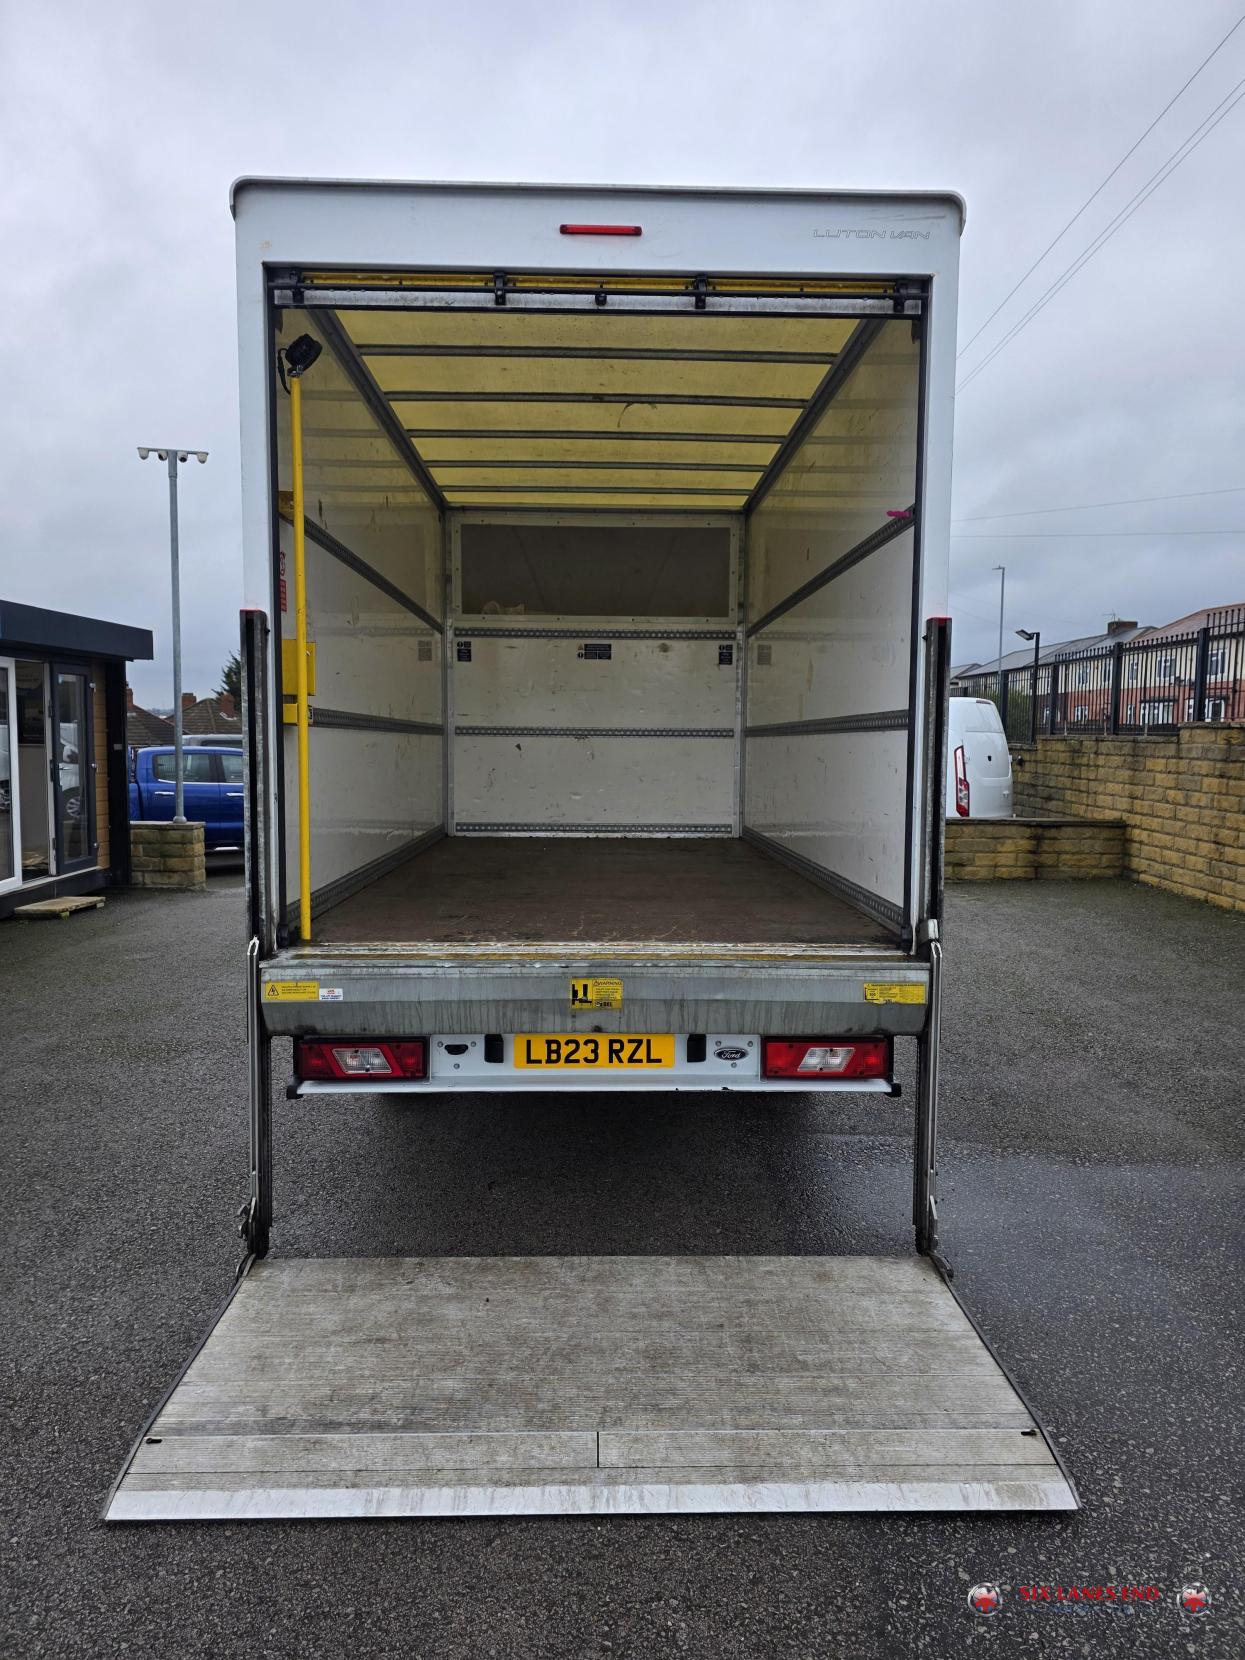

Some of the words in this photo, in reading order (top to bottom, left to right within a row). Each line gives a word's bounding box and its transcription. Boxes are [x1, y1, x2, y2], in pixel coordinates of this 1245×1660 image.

[813, 229, 887, 239] LUTON
[890, 230, 931, 240] VAN
[525, 1038, 600, 1065] LB23
[608, 1038, 663, 1064] RZL
